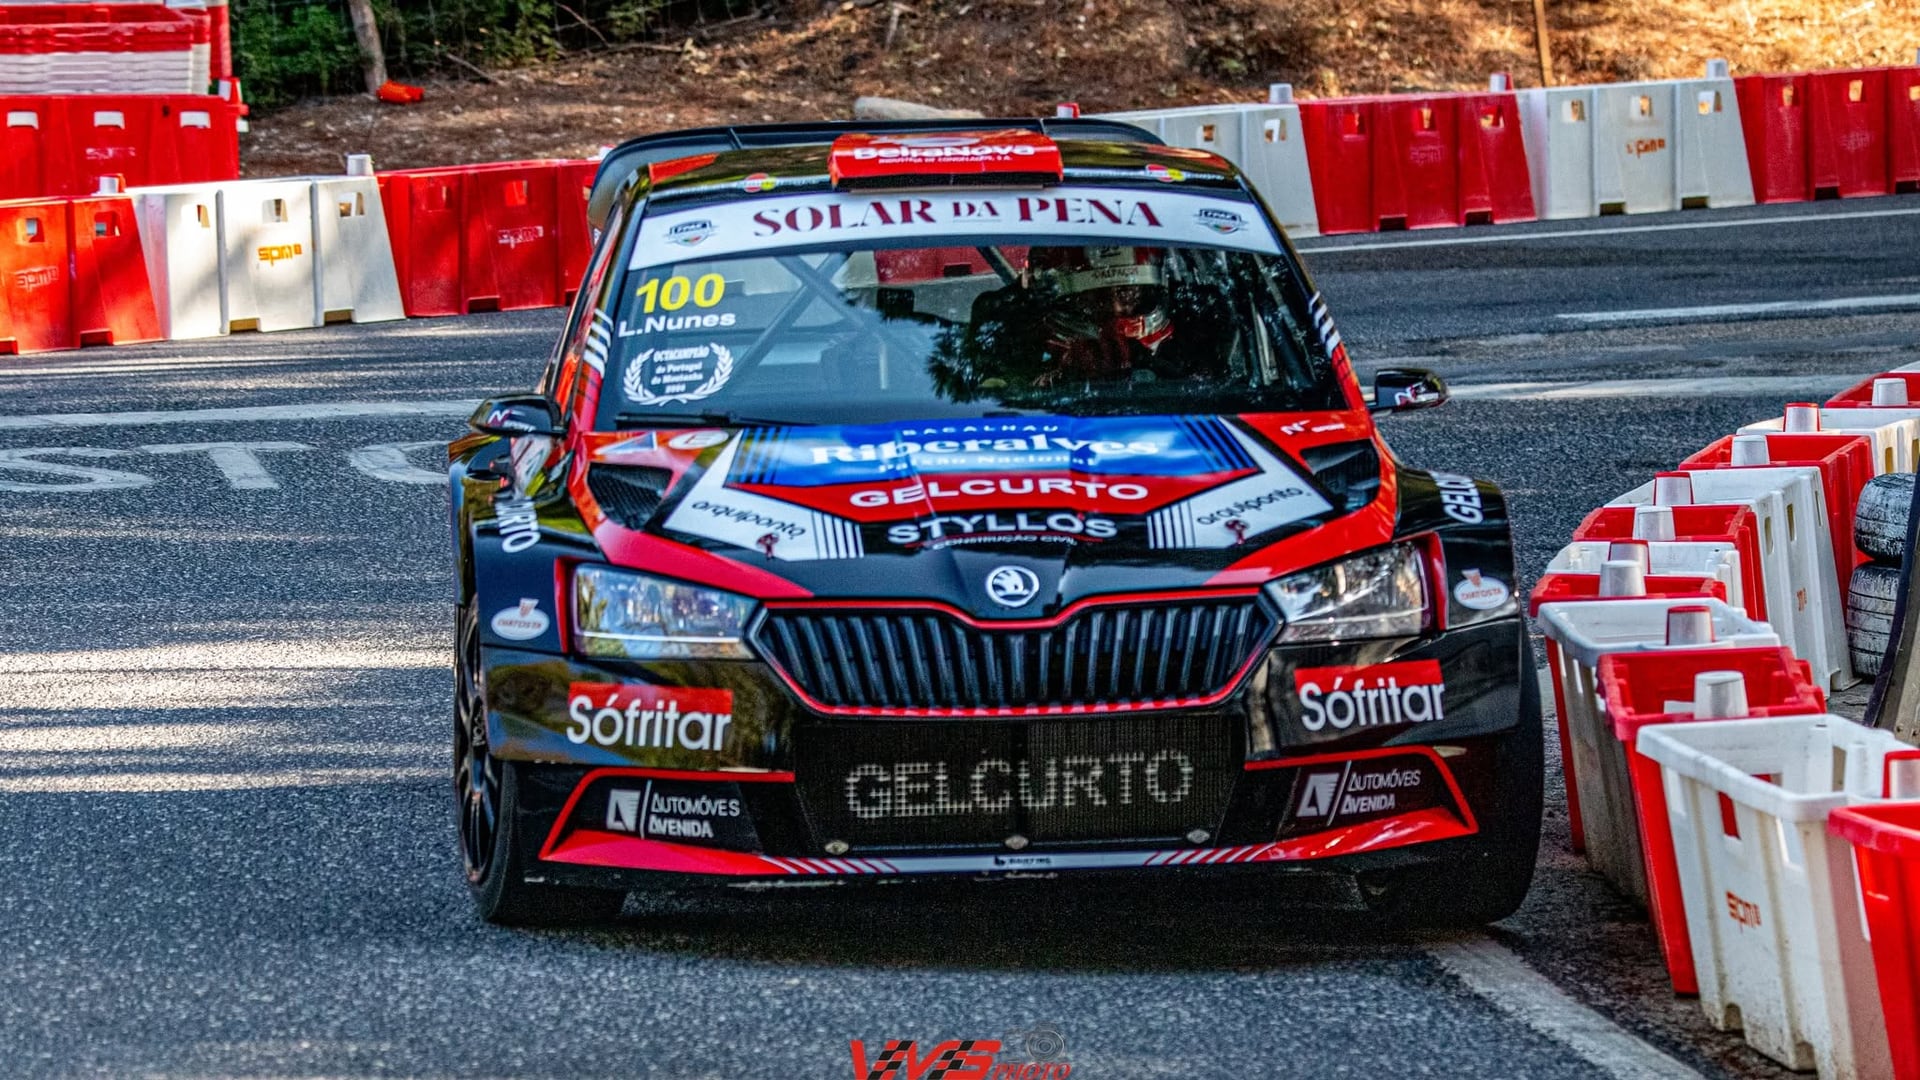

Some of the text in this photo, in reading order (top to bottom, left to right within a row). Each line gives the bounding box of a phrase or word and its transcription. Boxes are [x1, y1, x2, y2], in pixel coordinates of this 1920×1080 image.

[753, 198, 1163, 237] SOLAR DA PENA
[636, 273, 725, 314] 100
[618, 313, 736, 337] L.Nunes
[811, 433, 1159, 464] Riberalves
[903, 425, 1058, 436] BACALHAU
[850, 478, 1148, 508] GELCURTO
[1196, 486, 1304, 526] arquiponto
[692, 500, 806, 541] arquiponto
[566, 693, 733, 752] Sófritar
[1299, 676, 1446, 732] Sófritar
[846, 750, 1194, 819] GELCURTO
[1339, 794, 1396, 816] AVENIDA
[648, 815, 714, 838] AVENIDA
